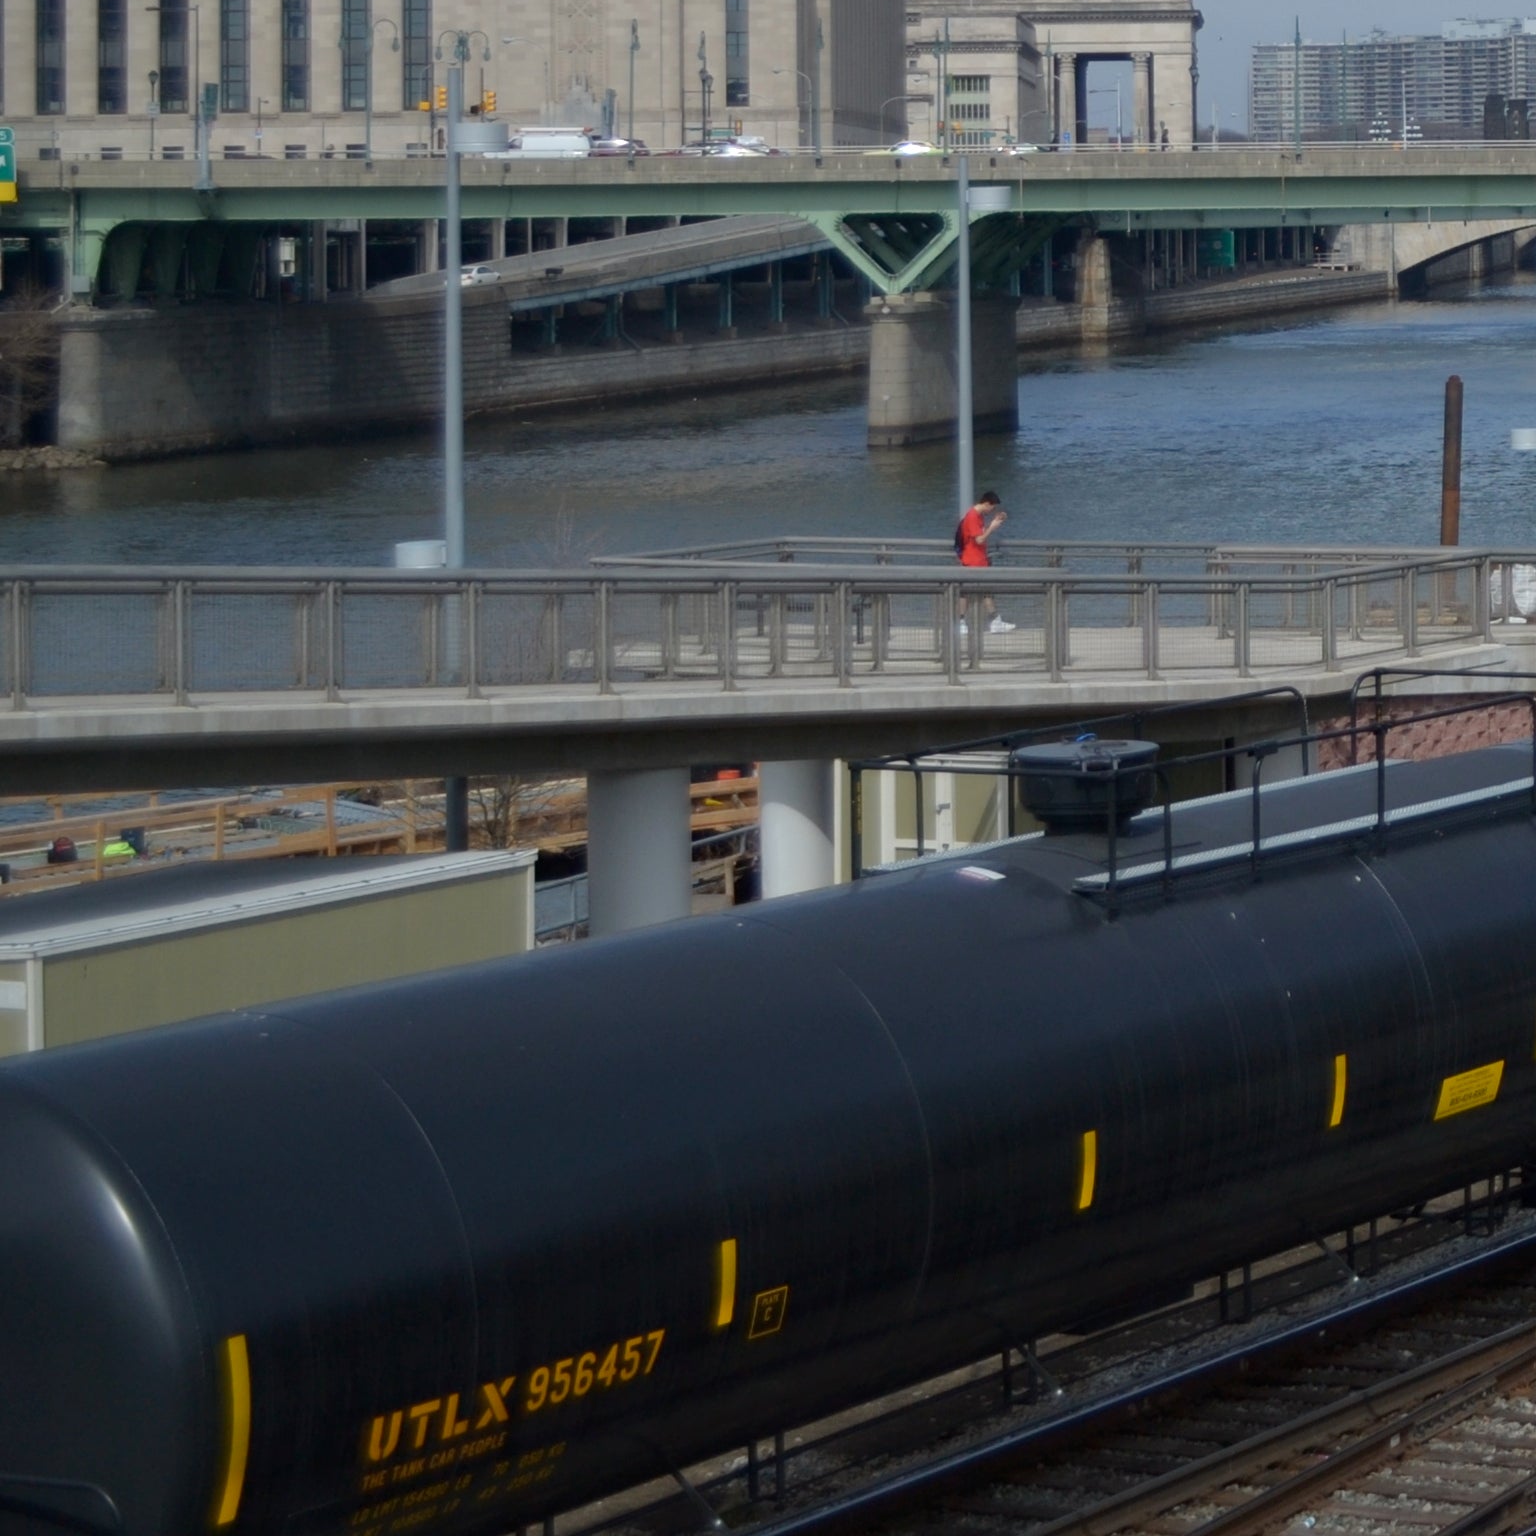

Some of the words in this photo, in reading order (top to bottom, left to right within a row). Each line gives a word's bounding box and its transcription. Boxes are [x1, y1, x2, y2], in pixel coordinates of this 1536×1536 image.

[367, 1375, 517, 1462] UTLX
[526, 1329, 666, 1412] 956457
[362, 1469, 386, 1492] THE
[392, 1458, 426, 1481] TANK
[429, 1448, 457, 1471] CAR
[460, 1432, 508, 1459] PEOPLE
